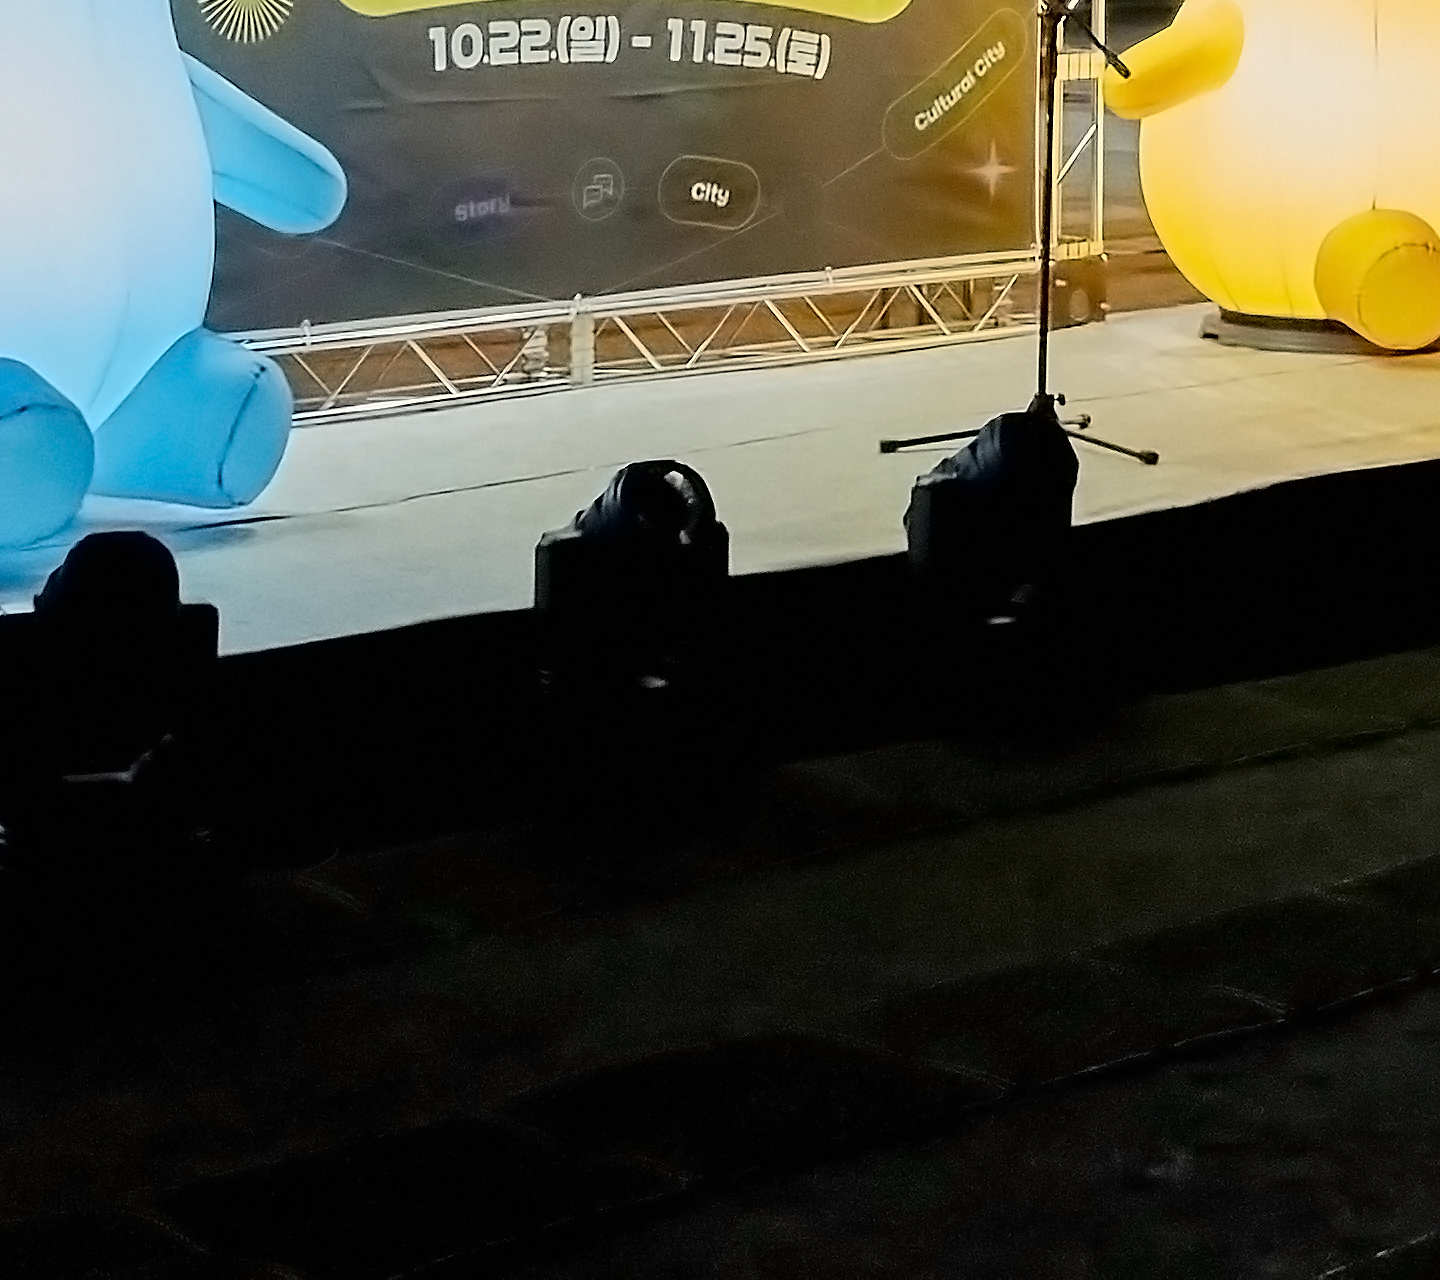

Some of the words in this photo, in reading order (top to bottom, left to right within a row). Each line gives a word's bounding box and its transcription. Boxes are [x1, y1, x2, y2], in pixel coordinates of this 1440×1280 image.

[428, 14, 621, 72] 10.22.(일)
[666, 16, 832, 81] 11.25.(토)
[914, 70, 977, 131] Cultural
[974, 41, 1006, 78] City
[689, 182, 731, 208] City
